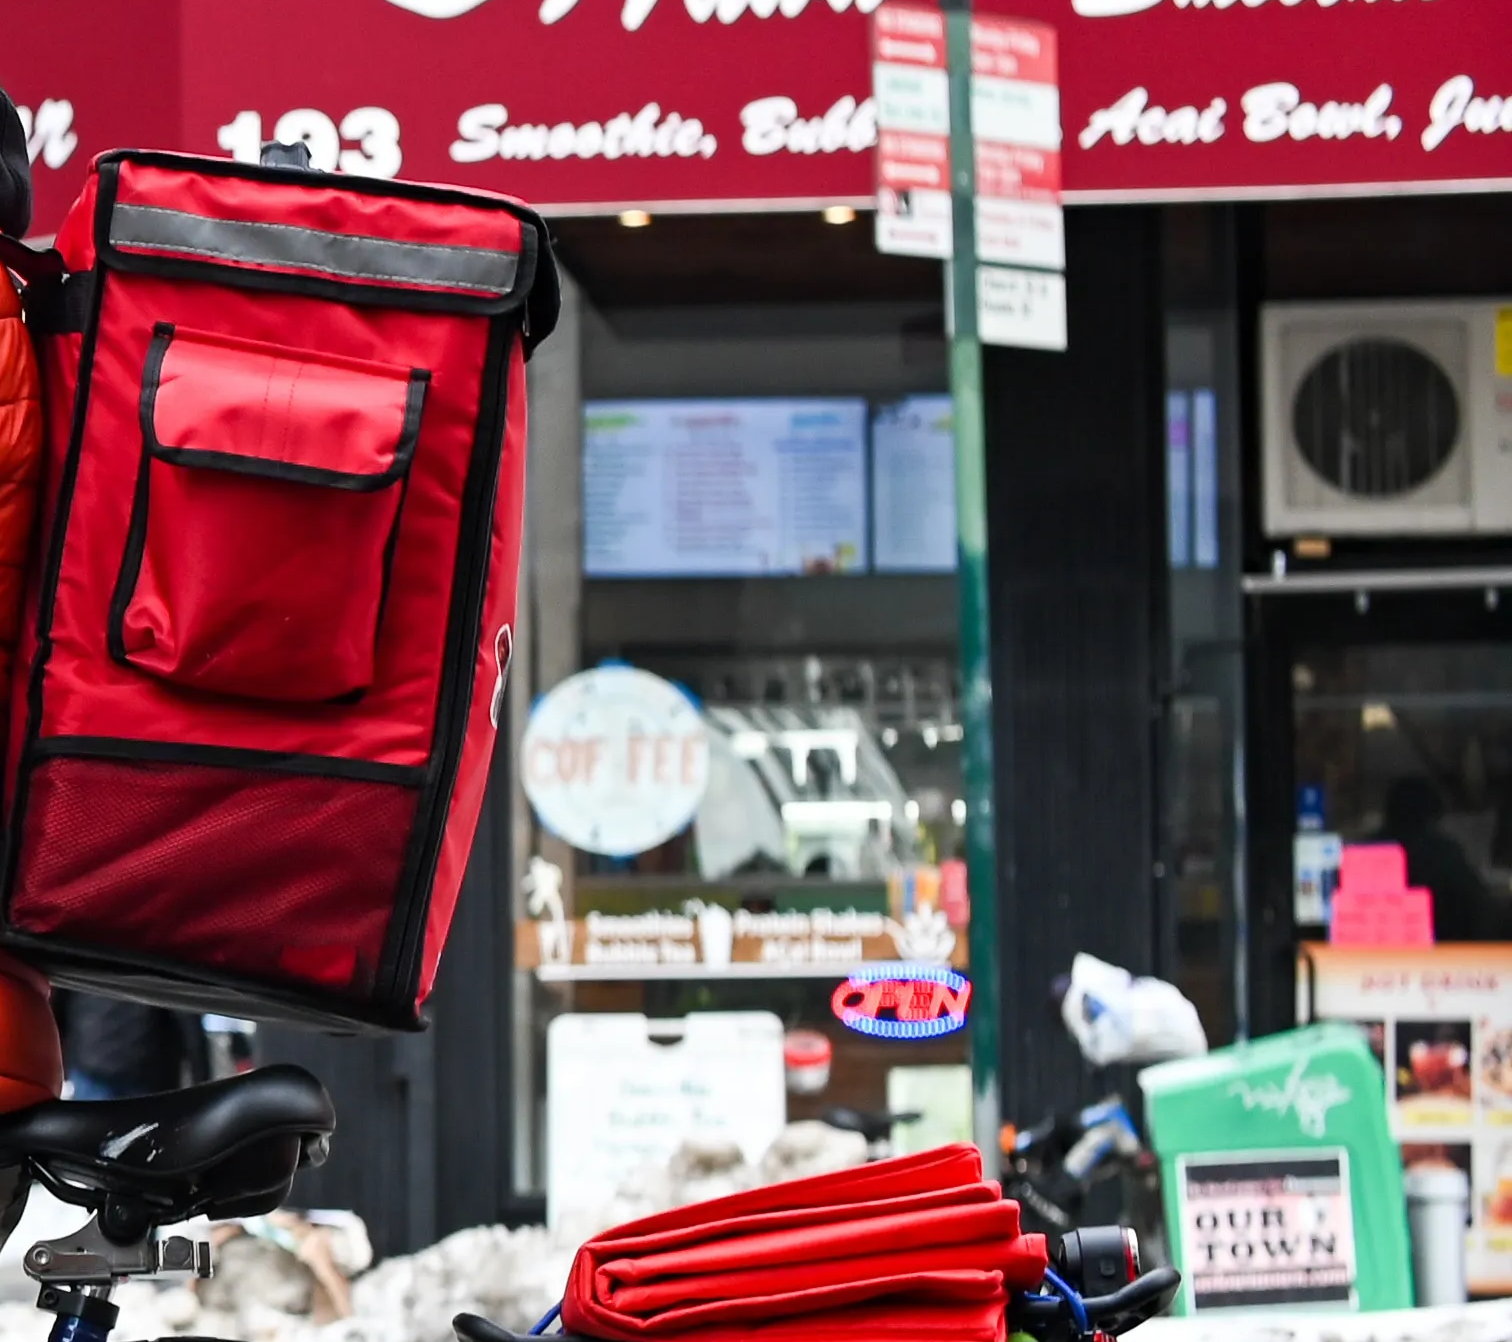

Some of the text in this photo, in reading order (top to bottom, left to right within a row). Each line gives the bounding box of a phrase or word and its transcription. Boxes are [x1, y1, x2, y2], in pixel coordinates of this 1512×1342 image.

[449, 101, 718, 162] Smoothie,
[1078, 86, 1227, 150] Acai
[1240, 81, 1402, 142] Bowl,
[1195, 1208, 1285, 1230] OUR
[1197, 1234, 1337, 1262] TOWN
